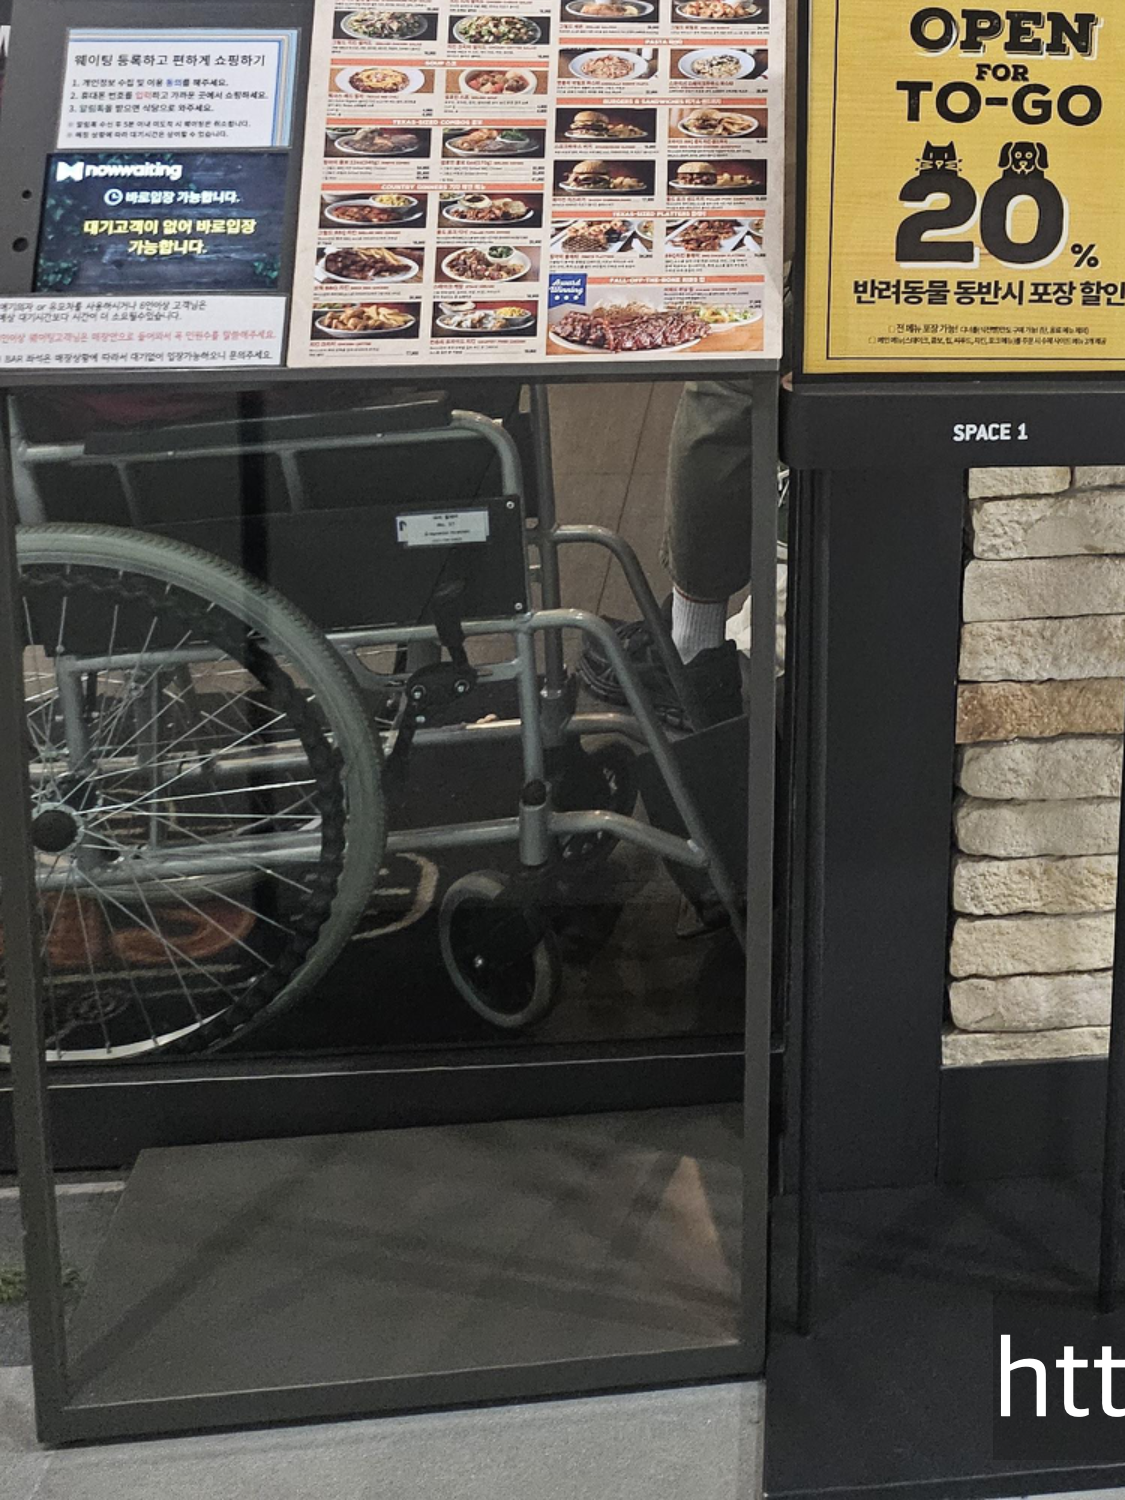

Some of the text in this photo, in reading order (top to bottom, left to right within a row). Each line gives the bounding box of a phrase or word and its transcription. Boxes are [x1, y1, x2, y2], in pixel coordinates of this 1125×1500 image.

[910, 7, 1100, 59] OPEN
[75, 54, 266, 67] 웨이팅 등록하고 편하게 쇼핑하기
[976, 64, 1029, 82] FOR
[72, 79, 79, 87] 1.
[83, 79, 116, 88] 개인정보
[71, 92, 78, 100] 2.
[896, 81, 1102, 126] TO-GO
[85, 161, 183, 181] nowwaiting
[126, 191, 240, 204] 바로입장 가능합니다.
[84, 219, 256, 235] 대기고객이 없어 바로입장
[128, 240, 207, 255] 가능합니다.
[853, 280, 1125, 307] 반려동물 동반시 포장 할인
[953, 422, 1028, 442] SPACE 1
